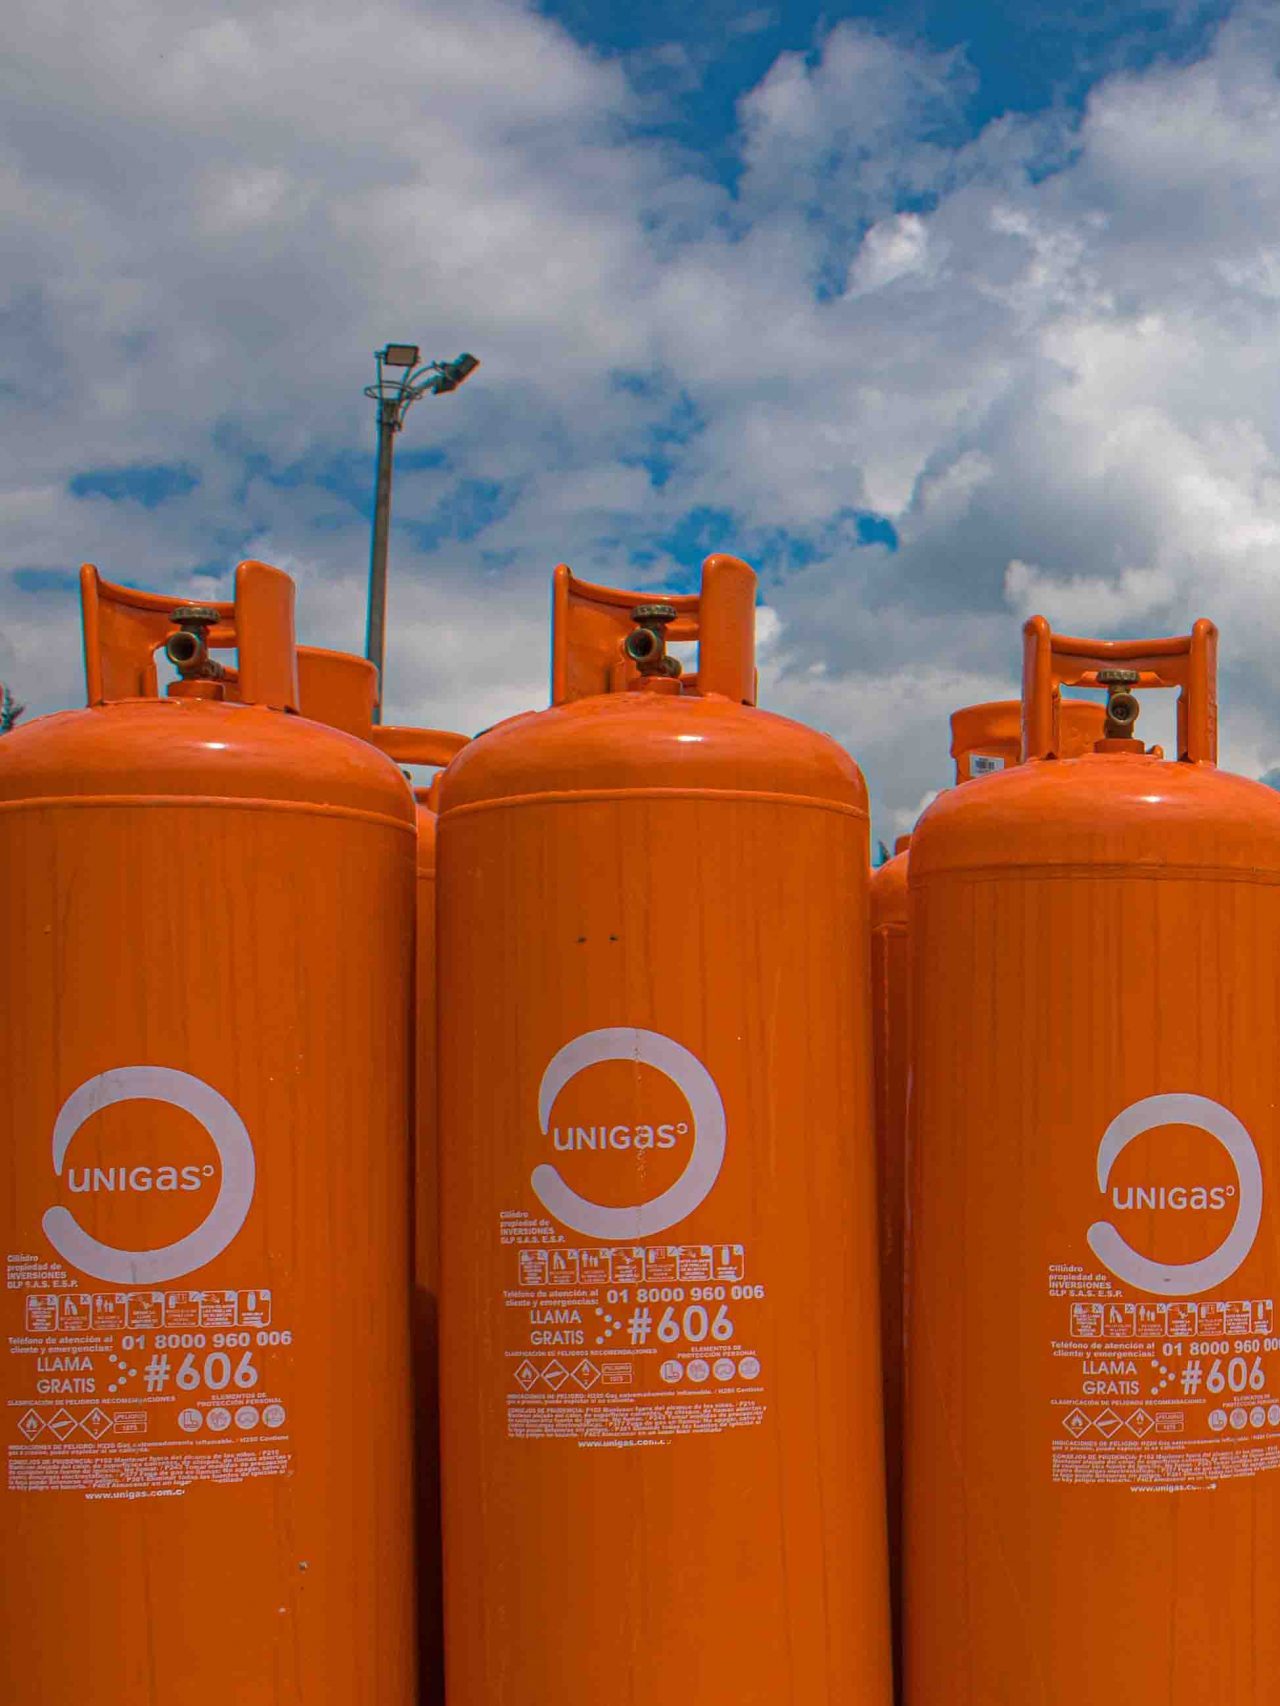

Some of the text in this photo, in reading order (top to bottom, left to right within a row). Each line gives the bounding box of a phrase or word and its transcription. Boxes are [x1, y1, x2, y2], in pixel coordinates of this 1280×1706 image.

[607, 1285, 765, 1304] 01 8000 960 006
[530, 1309, 582, 1324] LLAMA
[627, 1304, 734, 1345] #606
[45, 1336, 56, 1344] de
[103, 1335, 113, 1343] al
[122, 1330, 292, 1350] 01 8000 960 006
[530, 1330, 584, 1345] GRATIS
[1091, 1341, 1102, 1349] de
[1147, 1341, 1155, 1349] al
[1086, 1351, 1092, 1359] y
[1162, 1342, 1182, 1356] 01
[1189, 1341, 1230, 1355] 8000
[1234, 1339, 1260, 1354] 960
[37, 1356, 94, 1372] LLAMA
[144, 1351, 259, 1393] #606
[1082, 1360, 1138, 1375] LLAMA
[1181, 1355, 1265, 1395] #606
[37, 1378, 96, 1394] GRATIS
[1082, 1380, 1140, 1395] GRATIS
